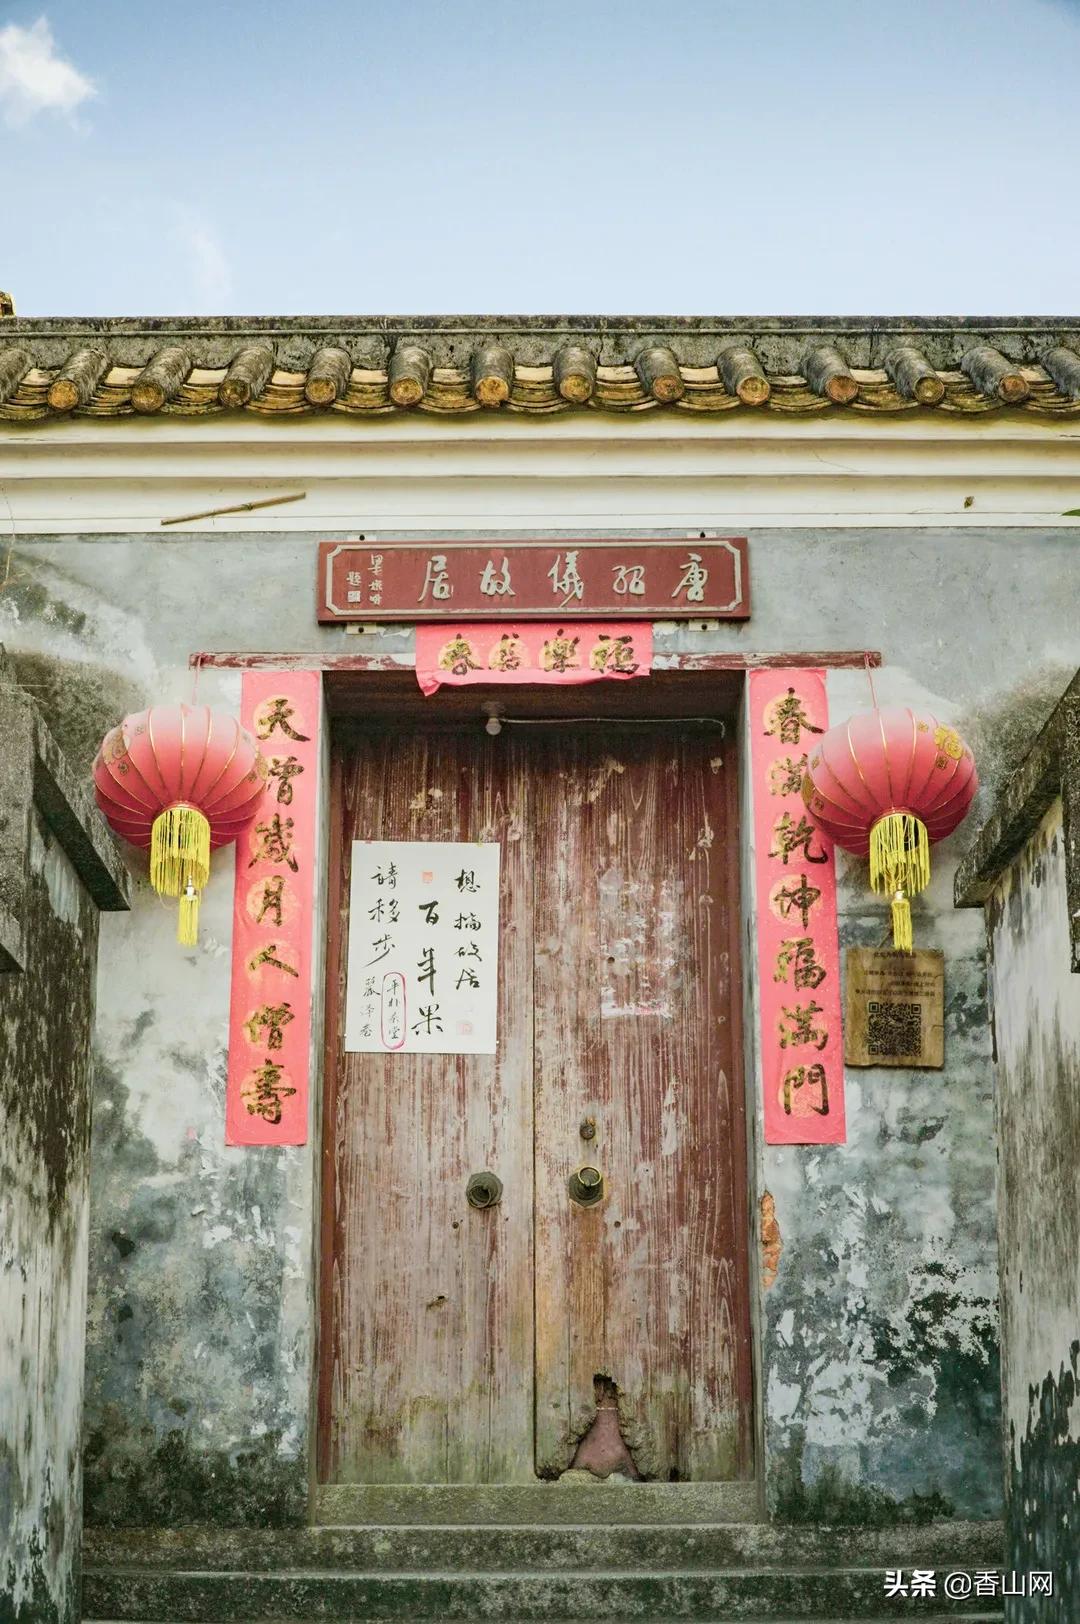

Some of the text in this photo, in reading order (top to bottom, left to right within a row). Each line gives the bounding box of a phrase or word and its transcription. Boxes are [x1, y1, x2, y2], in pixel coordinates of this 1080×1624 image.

[239, 698, 311, 1126] 天增歲月人增壽
[411, 900, 444, 1036] 百年果
